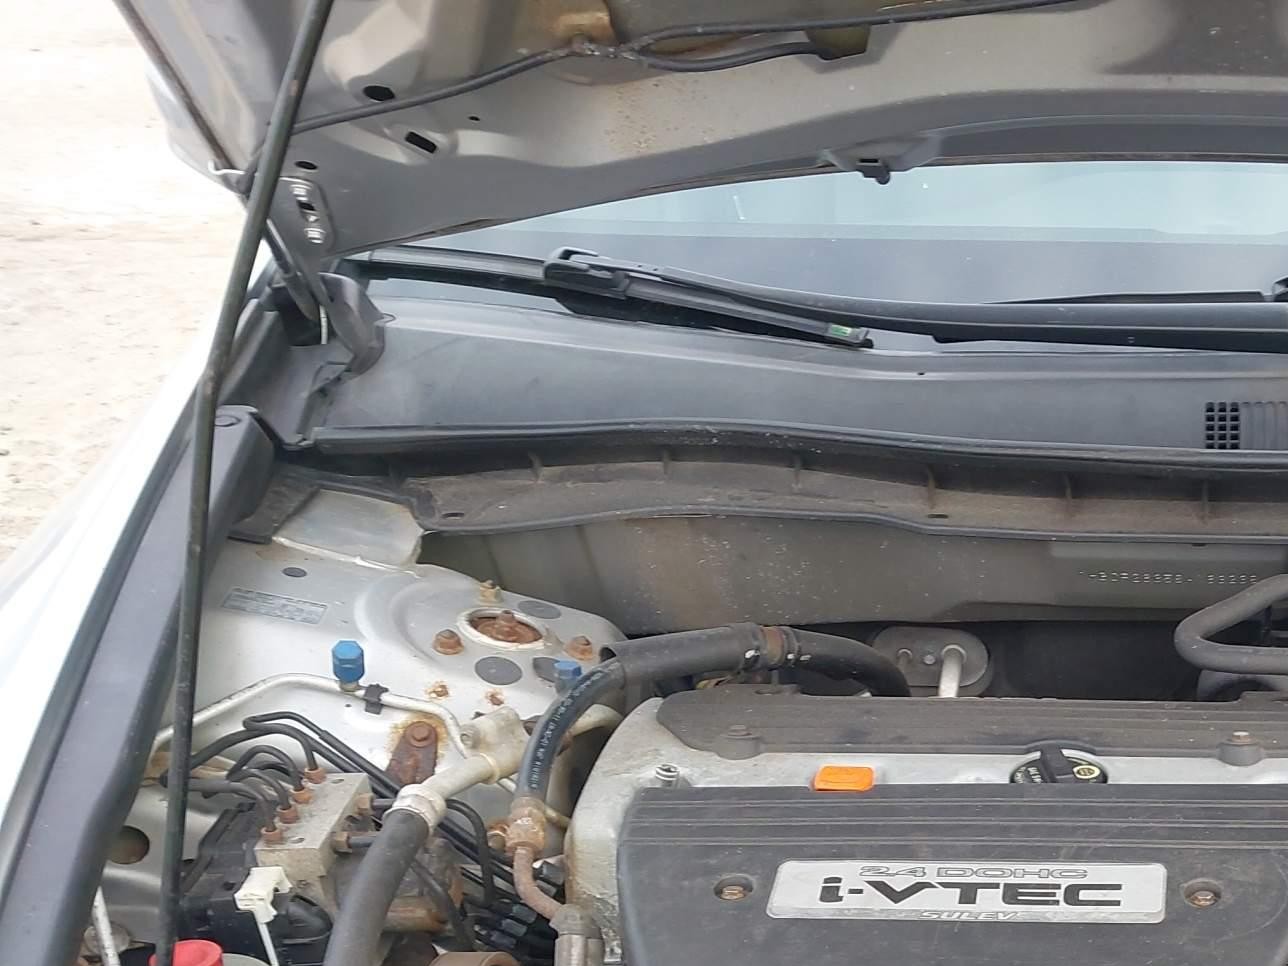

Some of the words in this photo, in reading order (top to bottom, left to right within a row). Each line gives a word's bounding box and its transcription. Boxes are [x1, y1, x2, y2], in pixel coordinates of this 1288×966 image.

[859, 865, 926, 879] 2.4
[936, 866, 1088, 880] DOHC
[818, 876, 1122, 907] i-VTEC
[919, 909, 1018, 922] SULEV
